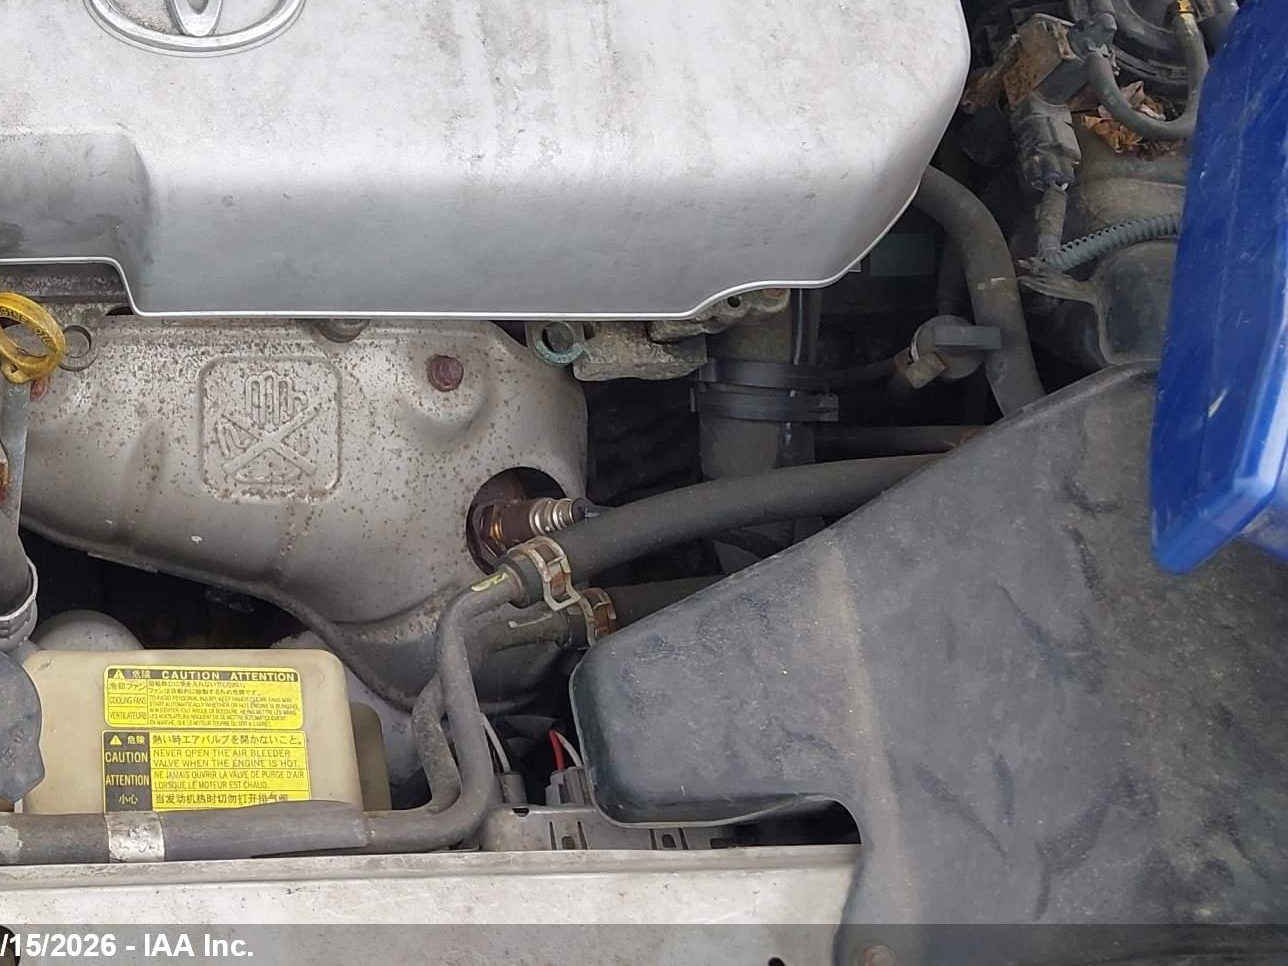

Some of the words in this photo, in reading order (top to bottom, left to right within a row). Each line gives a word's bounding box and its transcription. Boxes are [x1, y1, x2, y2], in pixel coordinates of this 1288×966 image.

[161, 670, 220, 680] CAUTION
[230, 672, 294, 682] ATTENTION
[109, 696, 133, 704] COOLING
[133, 696, 147, 704] FANS
[109, 711, 147, 720] VENTILATEURS
[105, 751, 149, 763] CAUTION
[153, 749, 182, 757] NEVER
[185, 749, 209, 757] OPEN
[213, 749, 230, 757] THE
[232, 749, 247, 757] AIR
[250, 749, 290, 757] BLEEDER
[153, 759, 179, 767] VALVE
[182, 759, 209, 767] WHEN
[213, 759, 230, 767] THE
[232, 759, 266, 768] ENGINE
[269, 759, 277, 767] IS
[154, 771, 163, 779] NE
[166, 771, 190, 779] JAMAIS
[191, 771, 217, 779] OUVRIR
[219, 771, 228, 779] LA
[229, 771, 249, 779] VALVE
[251, 771, 261, 779] DE
[261, 771, 284, 779] PURGE
[286, 770, 304, 779] D'AIR
[105, 774, 150, 786] ATTENTION
[154, 781, 188, 790] LORSQUE
[189, 781, 197, 789] LE
[198, 781, 227, 789] MOTEUR
[229, 781, 241, 789] EST
[118, 794, 138, 805] 小心
